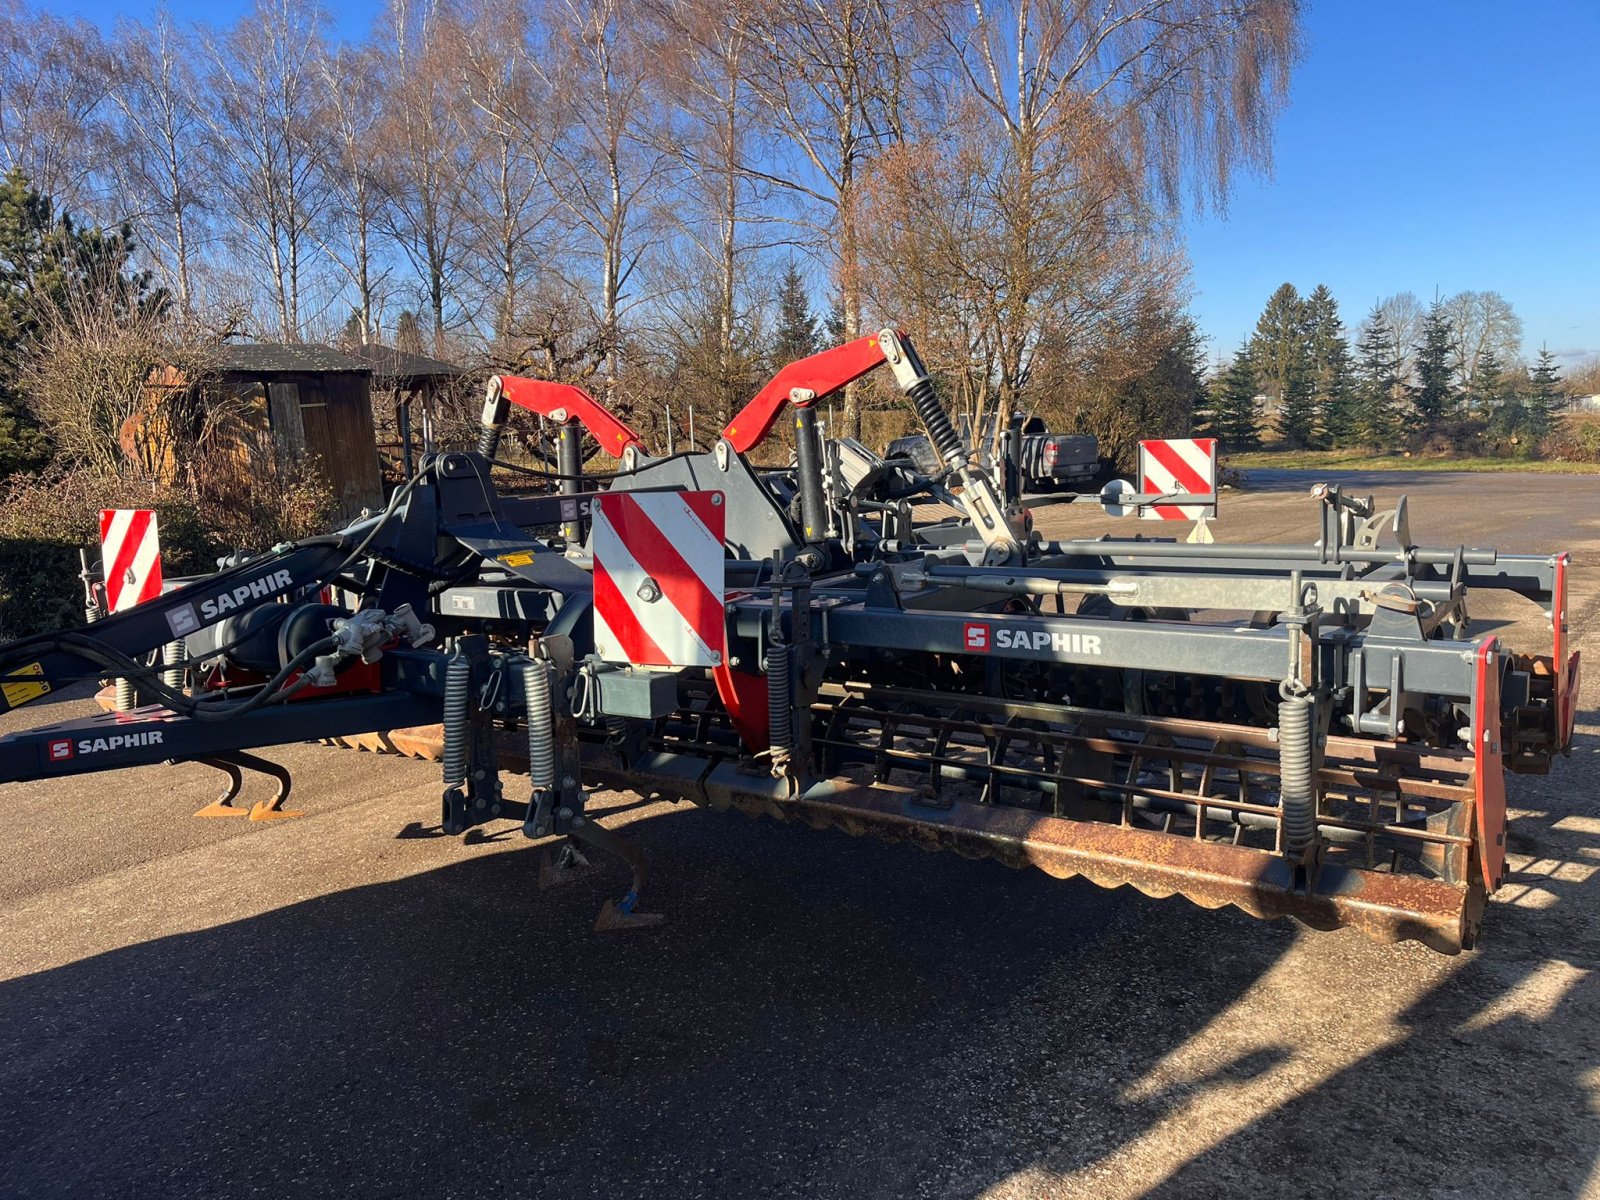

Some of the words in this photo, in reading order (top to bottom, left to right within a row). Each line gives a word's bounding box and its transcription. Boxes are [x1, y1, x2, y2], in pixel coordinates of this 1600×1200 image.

[580, 501, 592, 516] S
[172, 608, 194, 632] S
[200, 569, 293, 620] SAPHIR
[967, 627, 986, 647] S
[996, 629, 1102, 655] SAPHIR
[53, 742, 69, 758] S
[78, 731, 164, 754] SAPHIR
